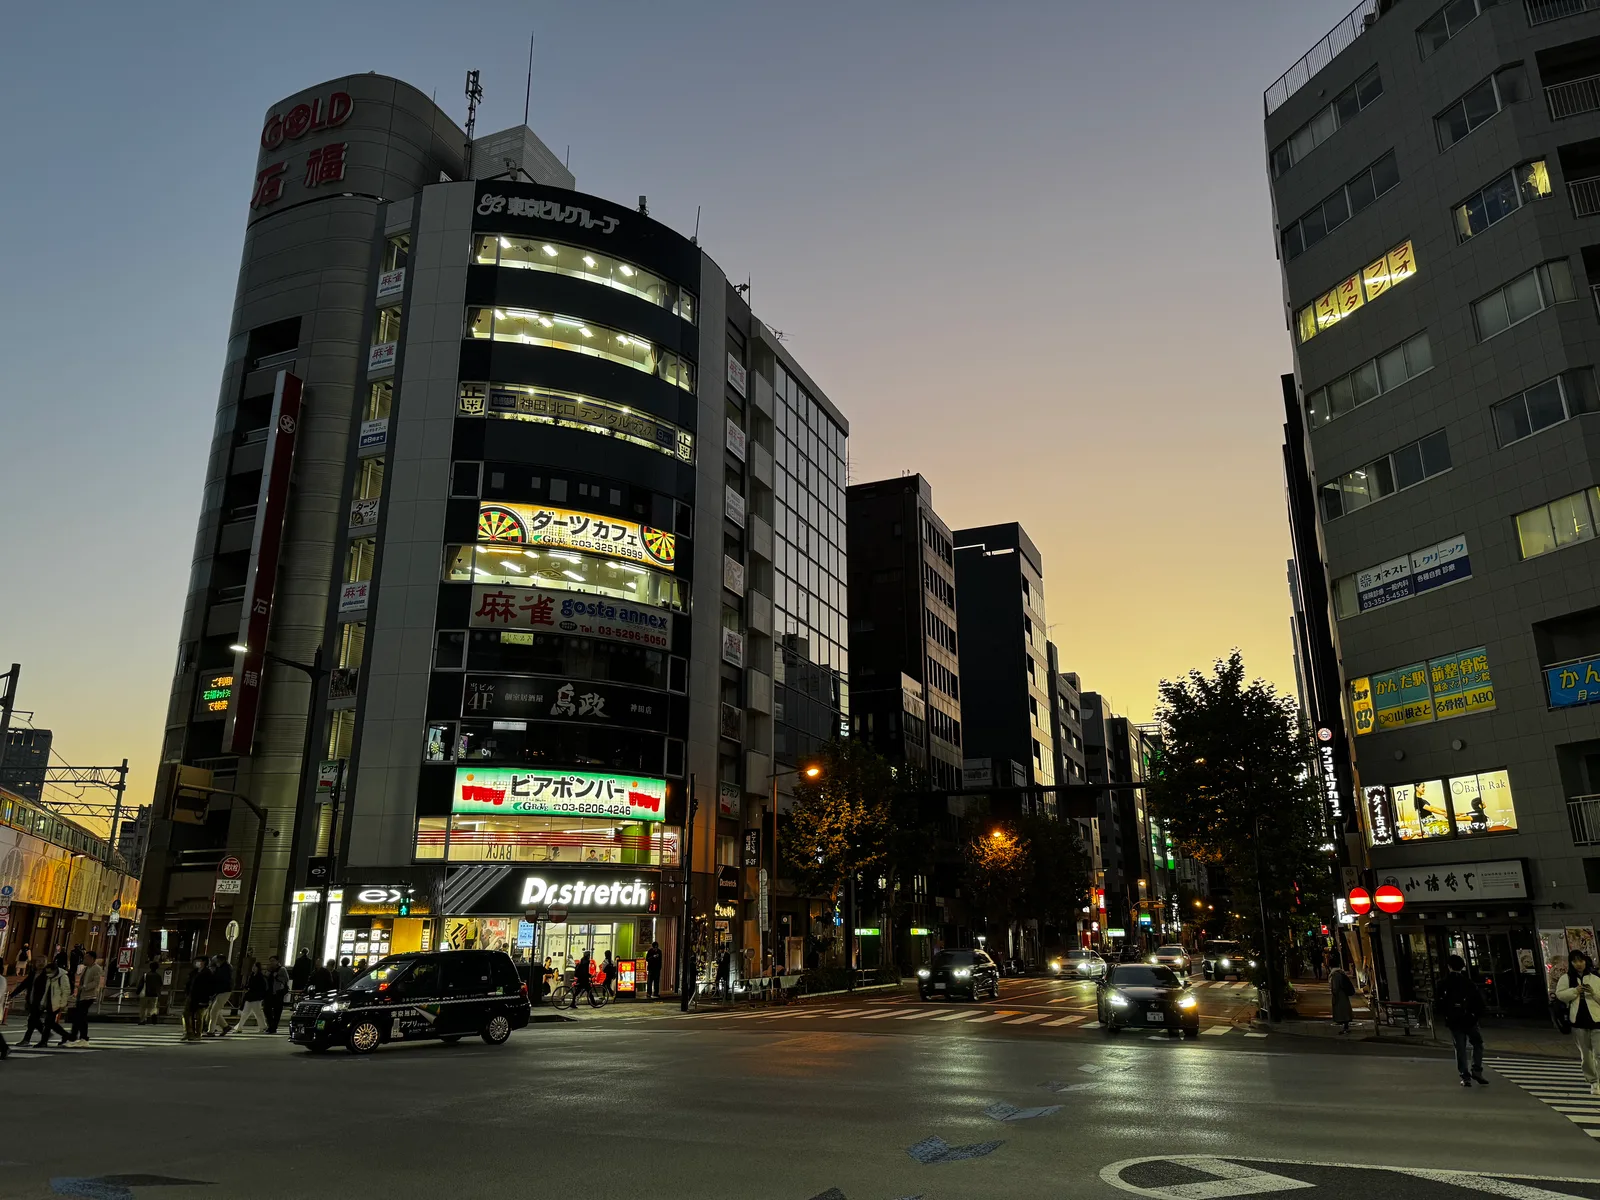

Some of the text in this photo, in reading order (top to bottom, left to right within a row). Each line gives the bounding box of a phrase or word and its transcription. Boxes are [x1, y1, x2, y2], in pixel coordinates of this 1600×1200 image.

[261, 92, 354, 151] GOLD
[250, 142, 350, 210] 石福
[506, 195, 620, 234] 東京ビルグループ
[531, 510, 638, 547] ダーツカフェ
[343, 584, 367, 599] 麻雀
[1363, 588, 1409, 609] 03-3525-4535
[475, 590, 667, 629] 麻雀 gosta annex
[580, 624, 595, 634] Tel.
[598, 626, 667, 647] 03-5296-5050
[467, 692, 495, 711] 4F
[629, 703, 653, 715] 神田店
[511, 774, 625, 800] ビアポンバー
[1396, 789, 1409, 802] 2F
[1488, 779, 1506, 790] Rak
[1373, 794, 1387, 838] タイ古式
[521, 877, 649, 905] Dr.stretch
